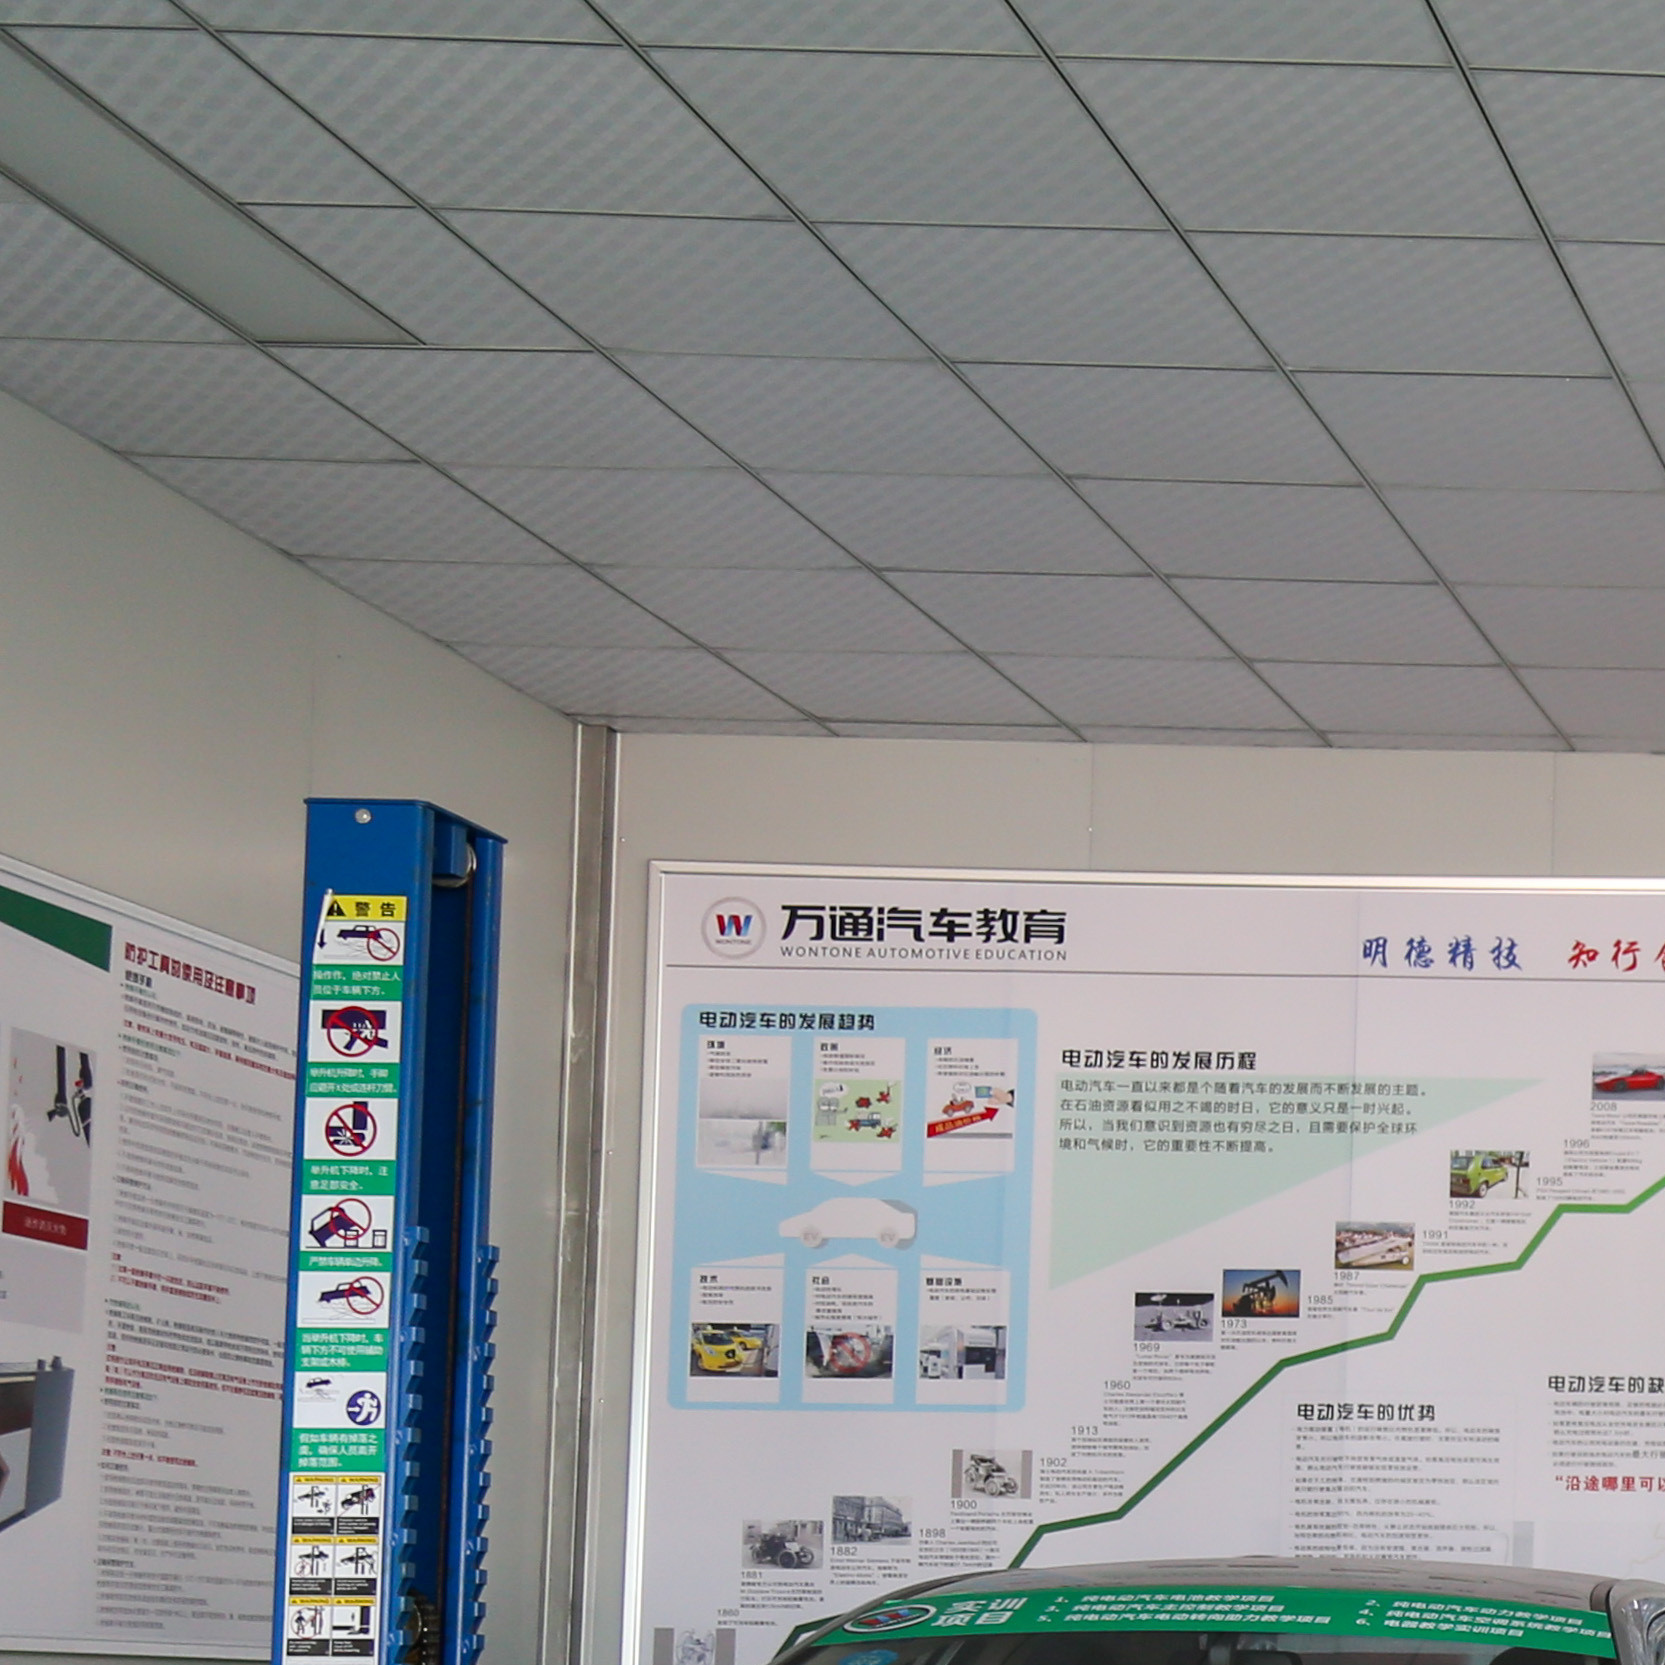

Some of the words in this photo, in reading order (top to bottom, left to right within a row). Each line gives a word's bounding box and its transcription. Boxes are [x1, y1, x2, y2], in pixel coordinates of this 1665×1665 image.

[354, 901, 397, 918] 警告
[715, 913, 753, 936] W
[781, 904, 1067, 945] 万通汽车教育
[780, 945, 862, 959] WONTONE
[867, 947, 970, 961] AUTOMOTIVE
[974, 948, 1068, 962] EDUCATION
[1361, 934, 1524, 972] 明德精技
[699, 1010, 875, 1031] 电动汽车的发展趋势
[1061, 1049, 1257, 1071] 电动汽车的发展历程
[1589, 1101, 1618, 1112] 2008
[1563, 1139, 1590, 1149] 1996
[1536, 1176, 1563, 1187] 1995
[1448, 1199, 1476, 1210] 1992
[1422, 1230, 1449, 1240] 1991
[1333, 1271, 1360, 1281] 1987
[1307, 1295, 1334, 1306] 1985
[1220, 1319, 1248, 1329] 1973
[1132, 1342, 1160, 1353] 1969
[1103, 1380, 1131, 1390] 1960
[1296, 1403, 1436, 1423] 电动汽车的优势
[1071, 1425, 1099, 1436] 1913
[1039, 1457, 1067, 1468] 1902
[950, 1500, 978, 1510] 1900
[919, 1528, 946, 1538] 1898
[830, 1546, 858, 1557] 1882
[740, 1570, 763, 1580] 1881
[942, 1597, 1029, 1614] 实训
[930, 1611, 1013, 1628] 项目
